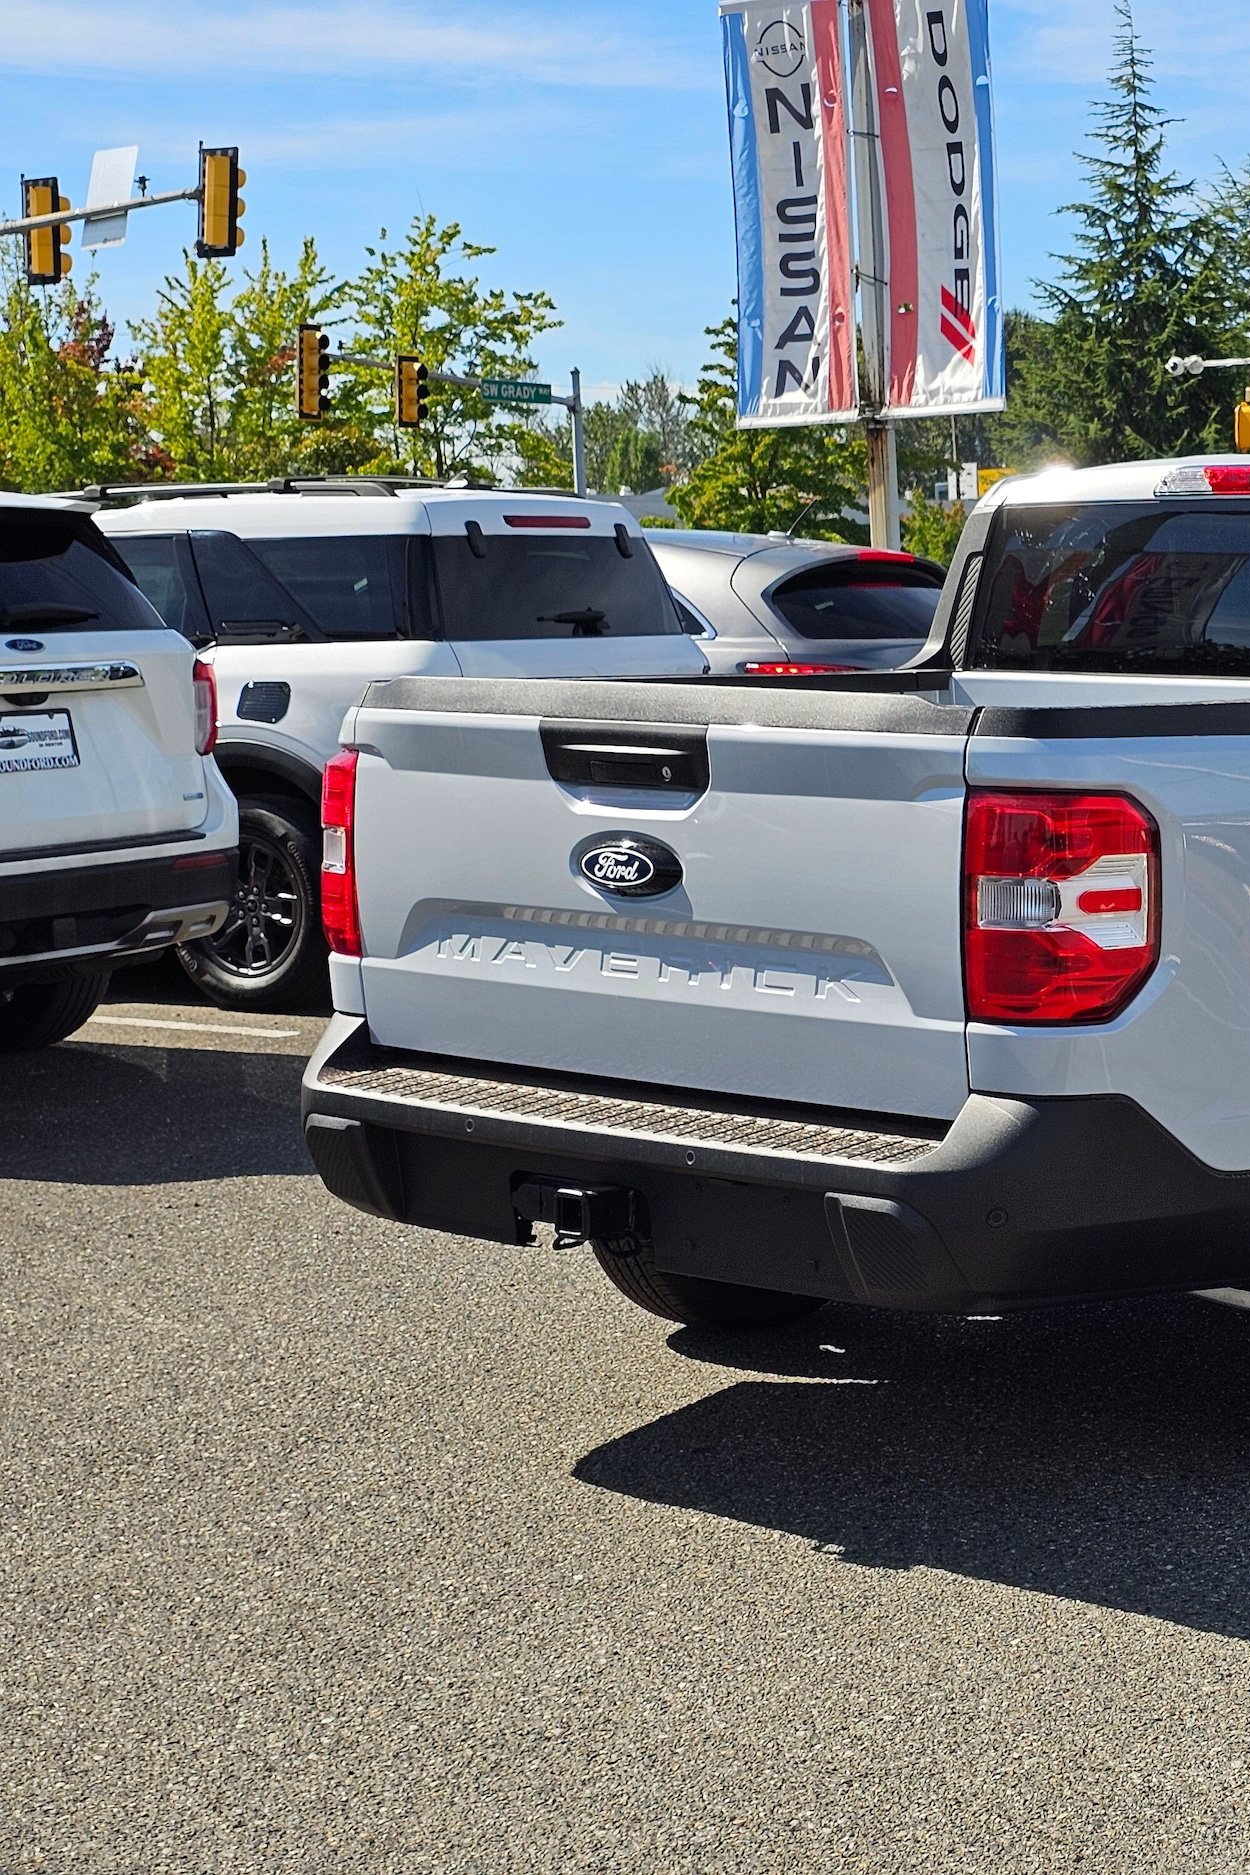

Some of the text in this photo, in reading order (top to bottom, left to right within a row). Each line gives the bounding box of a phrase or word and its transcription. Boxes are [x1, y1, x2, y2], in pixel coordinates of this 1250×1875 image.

[754, 41, 807, 57] NISSAN
[926, 10, 970, 318] DODGE
[765, 82, 820, 398] NISSAN
[482, 383, 499, 397] SW
[500, 384, 537, 399] GRADY
[594, 851, 638, 881] Ford
[437, 933, 862, 1004] MAVERICK
